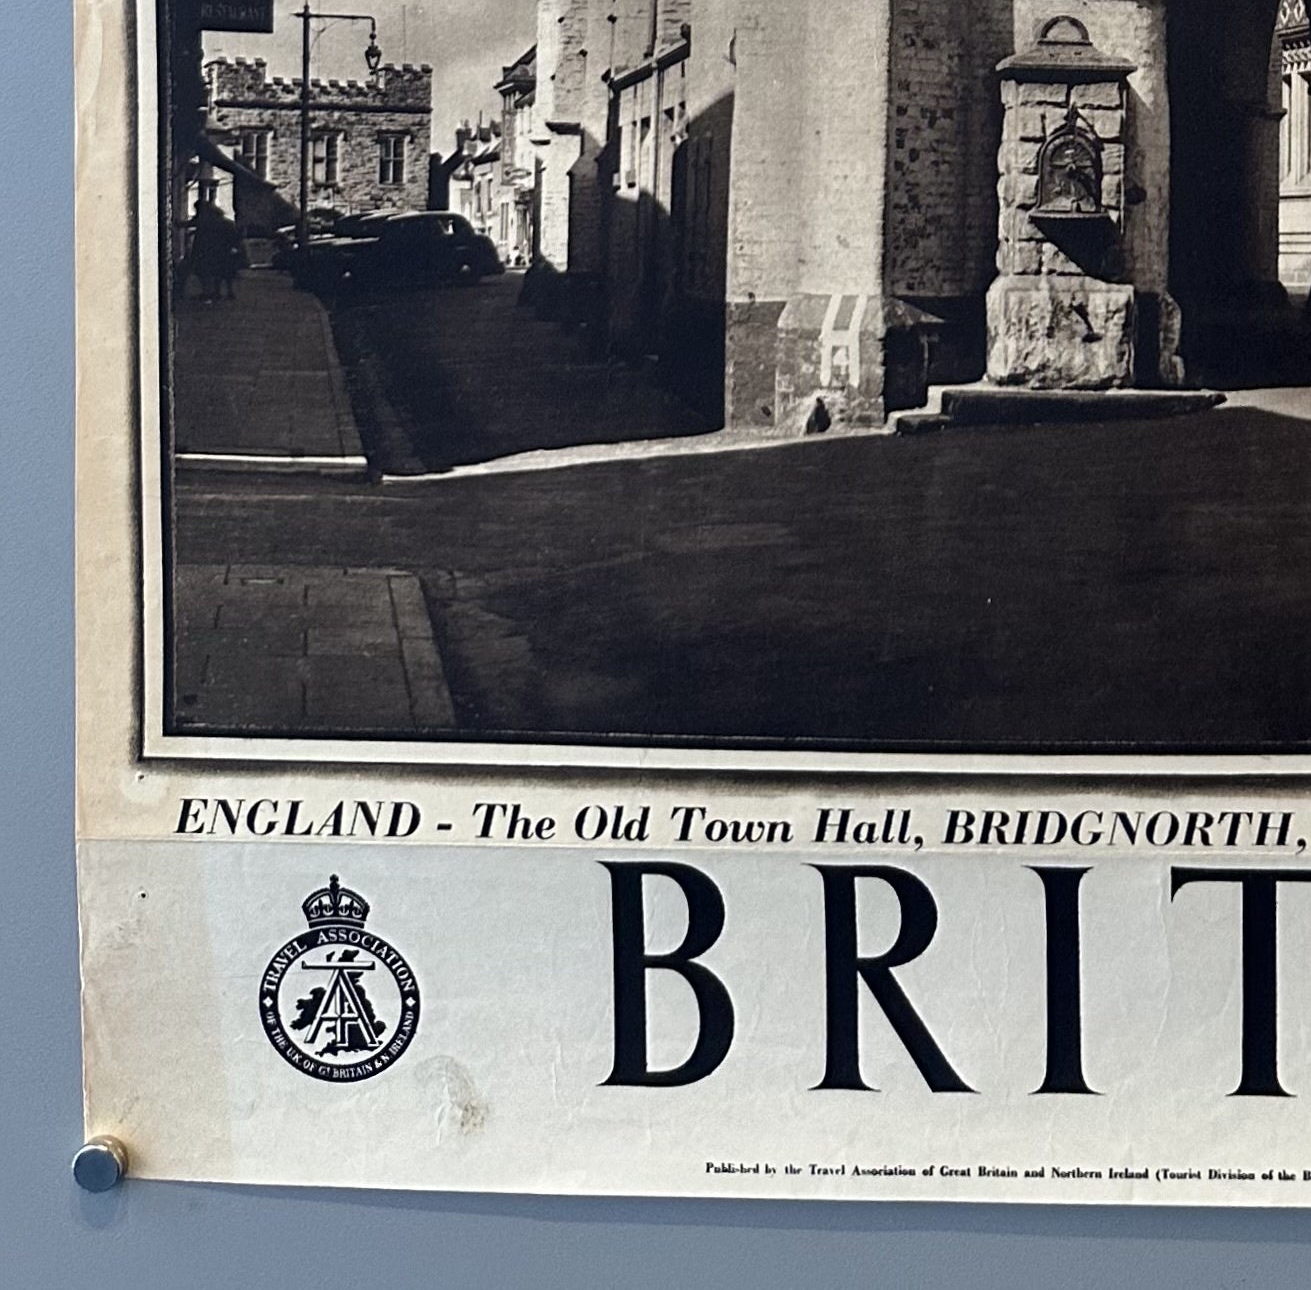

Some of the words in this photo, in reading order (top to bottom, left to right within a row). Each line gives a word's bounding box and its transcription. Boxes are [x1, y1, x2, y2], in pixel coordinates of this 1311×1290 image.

[174, 798, 421, 838] ENGLAND
[472, 802, 556, 841] The
[575, 805, 650, 842] Old
[670, 806, 794, 843] Town
[811, 808, 924, 851] Hall,
[940, 809, 1307, 855] BRIDGNORTH,
[263, 939, 307, 992] TRAVEL
[316, 929, 415, 992] ASSOCIATION
[266, 1011, 277, 1025] OF
[271, 1027, 288, 1049] THE
[388, 1011, 414, 1055] IRELAND
[303, 1059, 318, 1072] OF
[332, 1062, 373, 1078] BRITAIN
[705, 1161, 760, 1175] Published
[764, 1162, 777, 1178] by
[784, 1163, 803, 1176] the
[808, 1163, 846, 1176] Travel
[850, 1164, 917, 1177] Association
[921, 1164, 936, 1177] of
[939, 1164, 972, 1178] Great
[977, 1165, 1019, 1179] Britain
[1023, 1166, 1046, 1179] and
[1050, 1166, 1103, 1180] Northern
[1108, 1167, 1150, 1180] Ireland
[1155, 1167, 1202, 1183] (Tourist
[1207, 1168, 1256, 1181] Division
[1260, 1168, 1274, 1181] of
[1277, 1169, 1297, 1182] the
